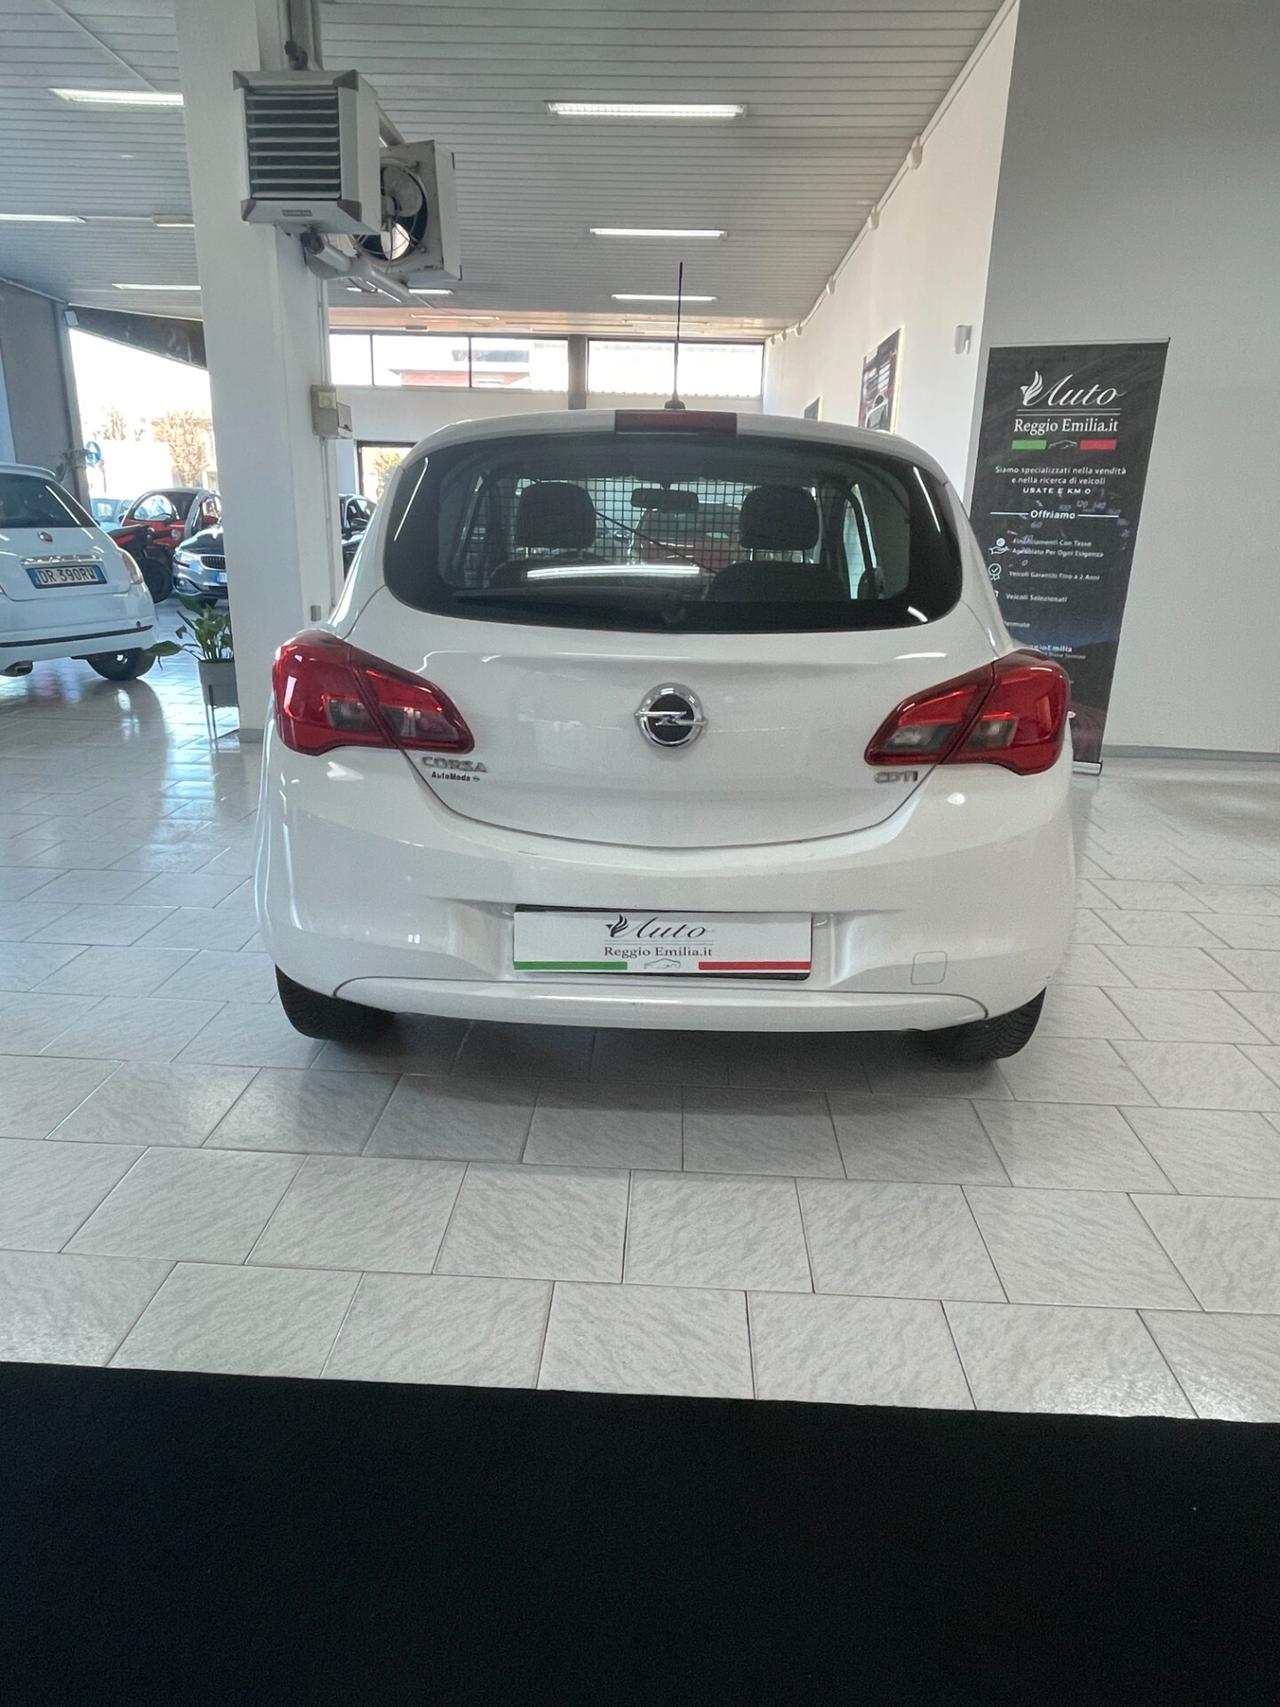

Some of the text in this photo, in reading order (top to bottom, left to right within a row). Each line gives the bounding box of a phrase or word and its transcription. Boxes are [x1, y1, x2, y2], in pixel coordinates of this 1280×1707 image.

[1021, 371, 1127, 407] Auto
[1014, 417, 1120, 436] Reggio Emilia.it
[995, 465, 1019, 474] Siamo
[1020, 466, 1071, 476] specializzati
[1072, 466, 1093, 475] nella
[1069, 477, 1077, 485] di
[1079, 477, 1106, 485] veicoli
[1030, 509, 1076, 519] Offriamo
[37, 569, 57, 584] DR
[422, 756, 488, 773] CORSA
[606, 914, 716, 939] Auto
[604, 946, 714, 959] Reggio Emilia.it
